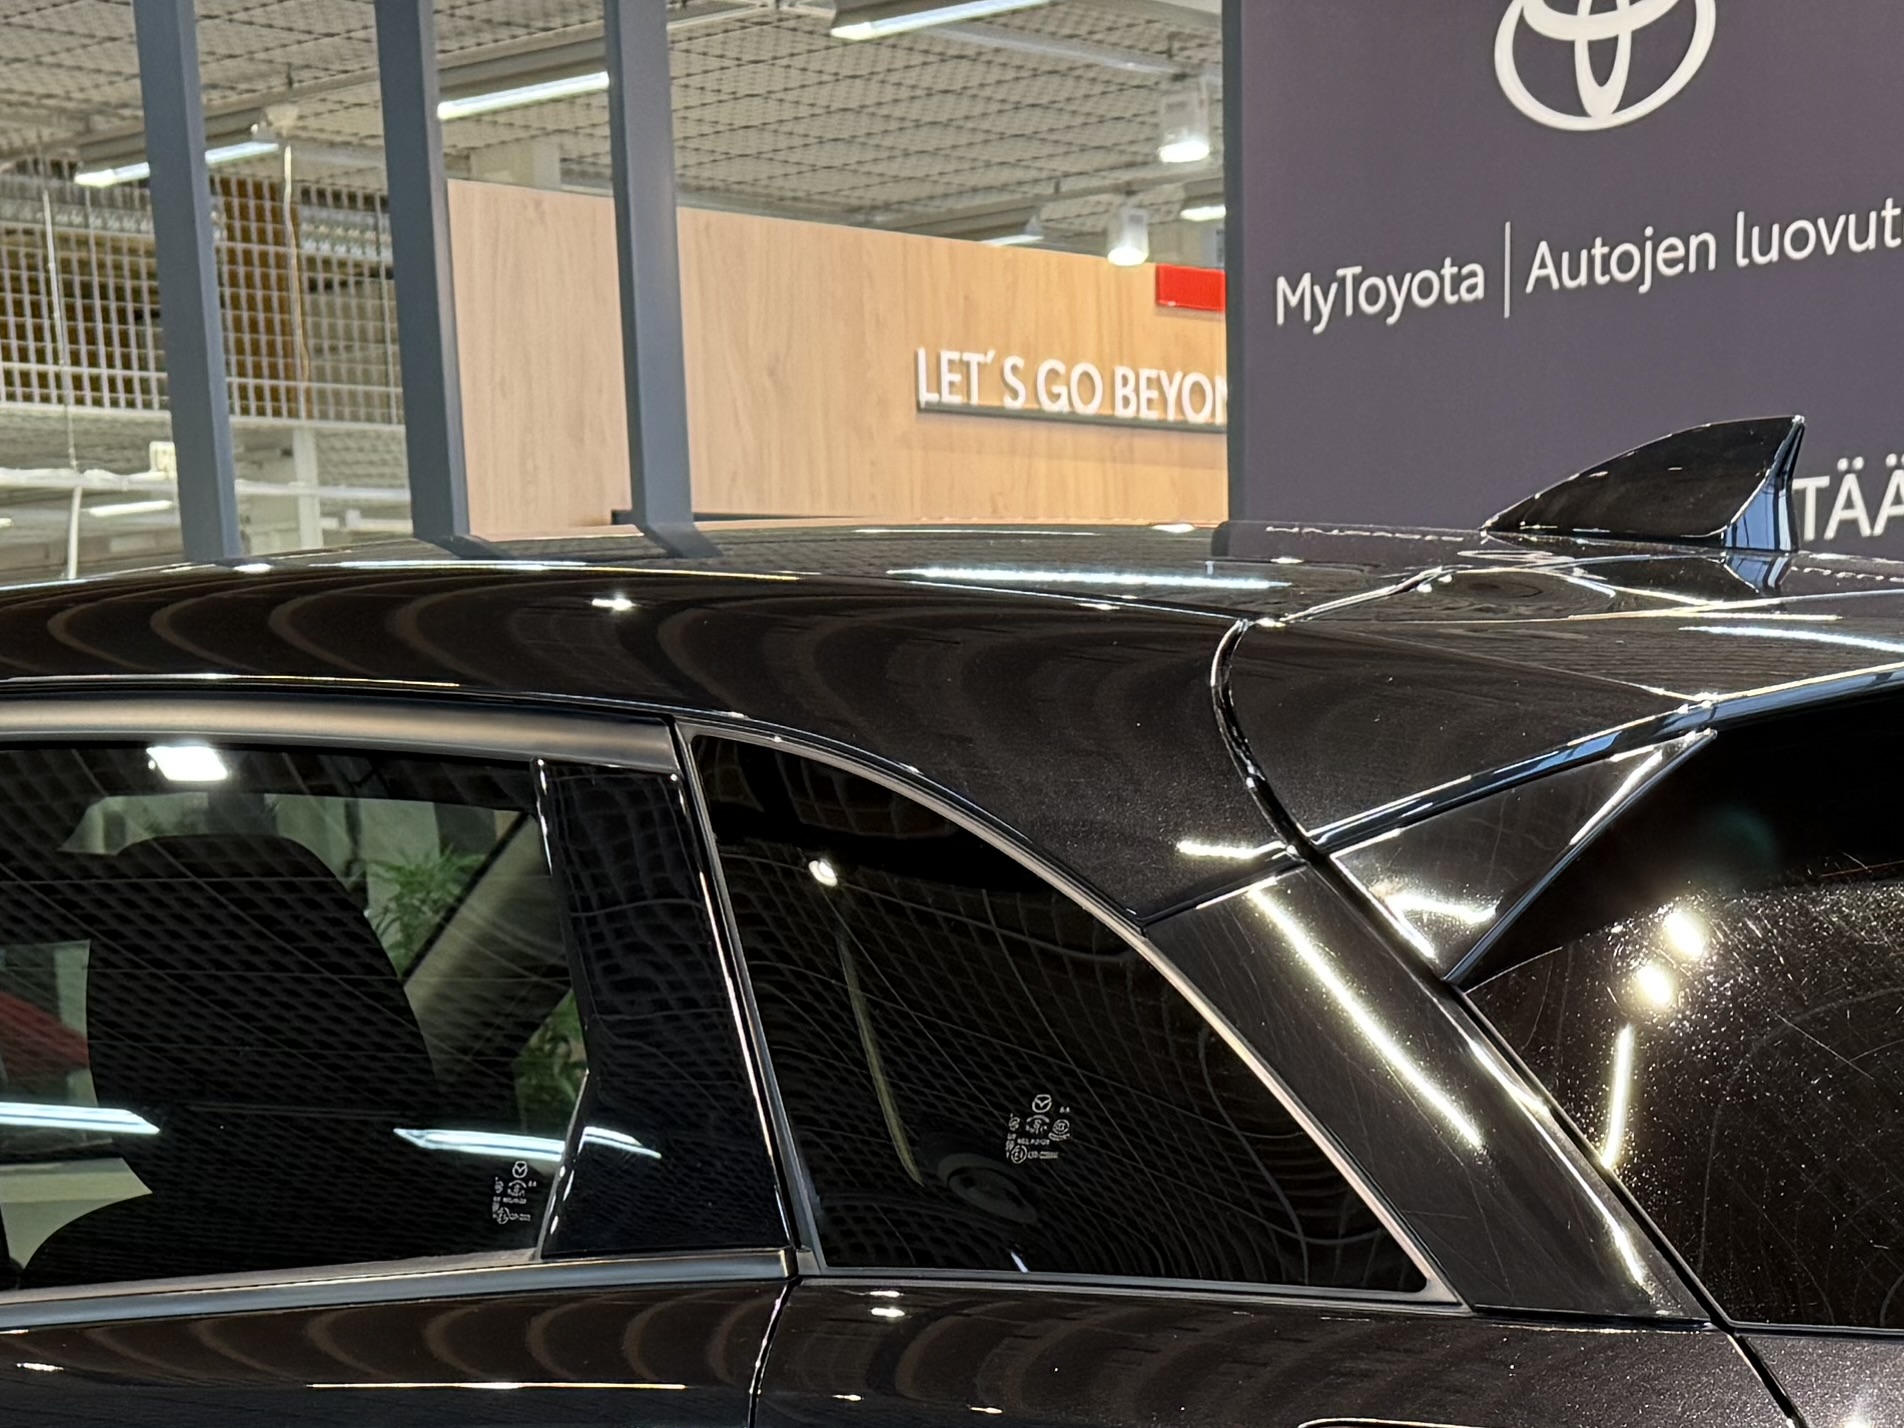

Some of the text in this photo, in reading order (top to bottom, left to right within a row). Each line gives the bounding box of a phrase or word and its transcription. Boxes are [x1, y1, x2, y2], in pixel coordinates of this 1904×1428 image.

[1276, 256, 1486, 335] MyToyota
[1525, 225, 1717, 294] Autojen
[1037, 358, 1104, 415] GO
